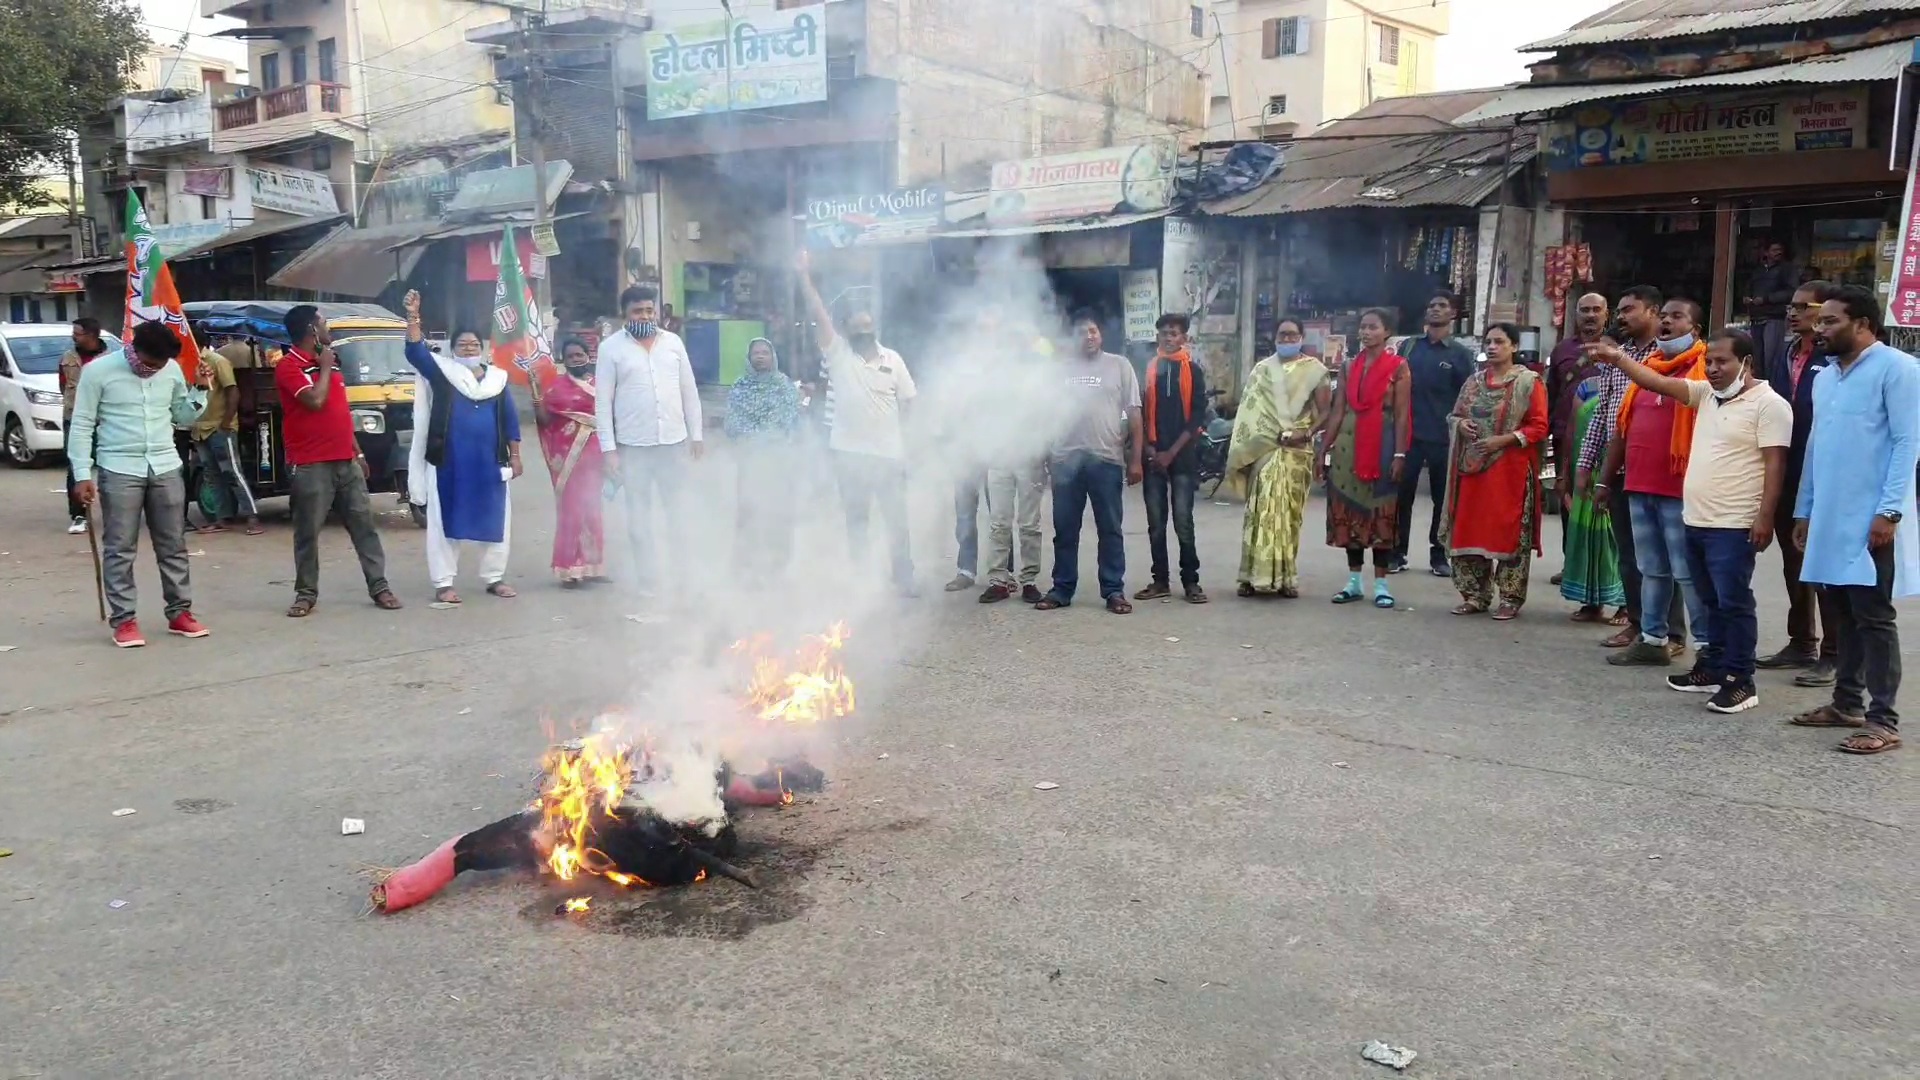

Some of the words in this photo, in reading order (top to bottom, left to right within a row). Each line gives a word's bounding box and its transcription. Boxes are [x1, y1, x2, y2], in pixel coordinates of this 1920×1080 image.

[650, 34, 727, 82] होटल
[732, 12, 817, 69] मिष्टी
[1716, 102, 1780, 129] महल
[869, 188, 938, 215] Mobile
[1903, 290, 1917, 306] 84
